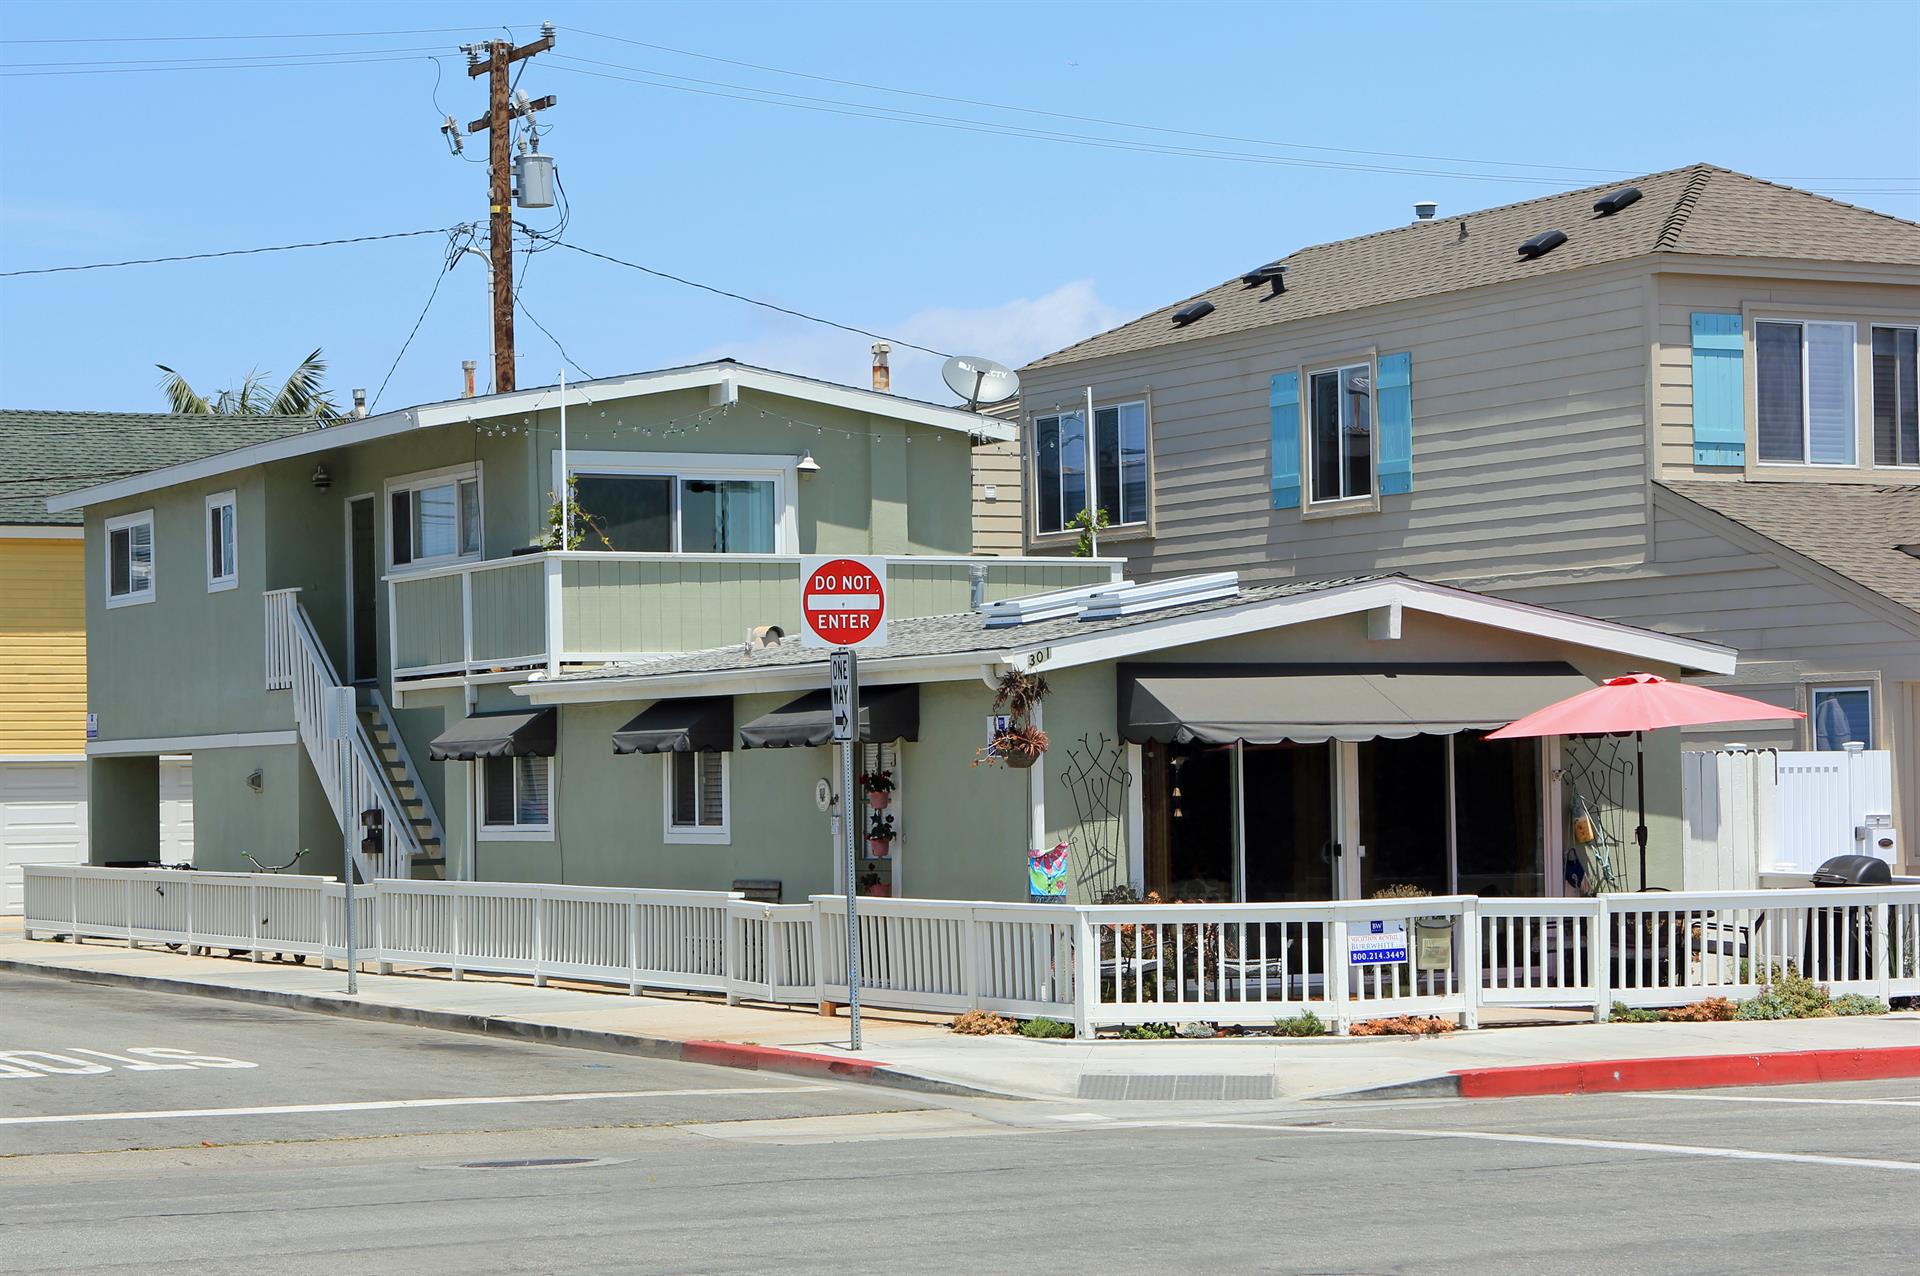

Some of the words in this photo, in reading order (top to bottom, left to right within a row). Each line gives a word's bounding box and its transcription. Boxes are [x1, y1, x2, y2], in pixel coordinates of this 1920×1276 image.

[815, 575, 837, 591] DO
[842, 575, 872, 590] NOT
[818, 614, 870, 629] ENTER
[1029, 647, 1050, 667] 301
[832, 661, 848, 680] ONE
[833, 685, 849, 705] WAY
[1352, 951, 1405, 961] 800.214.3449
